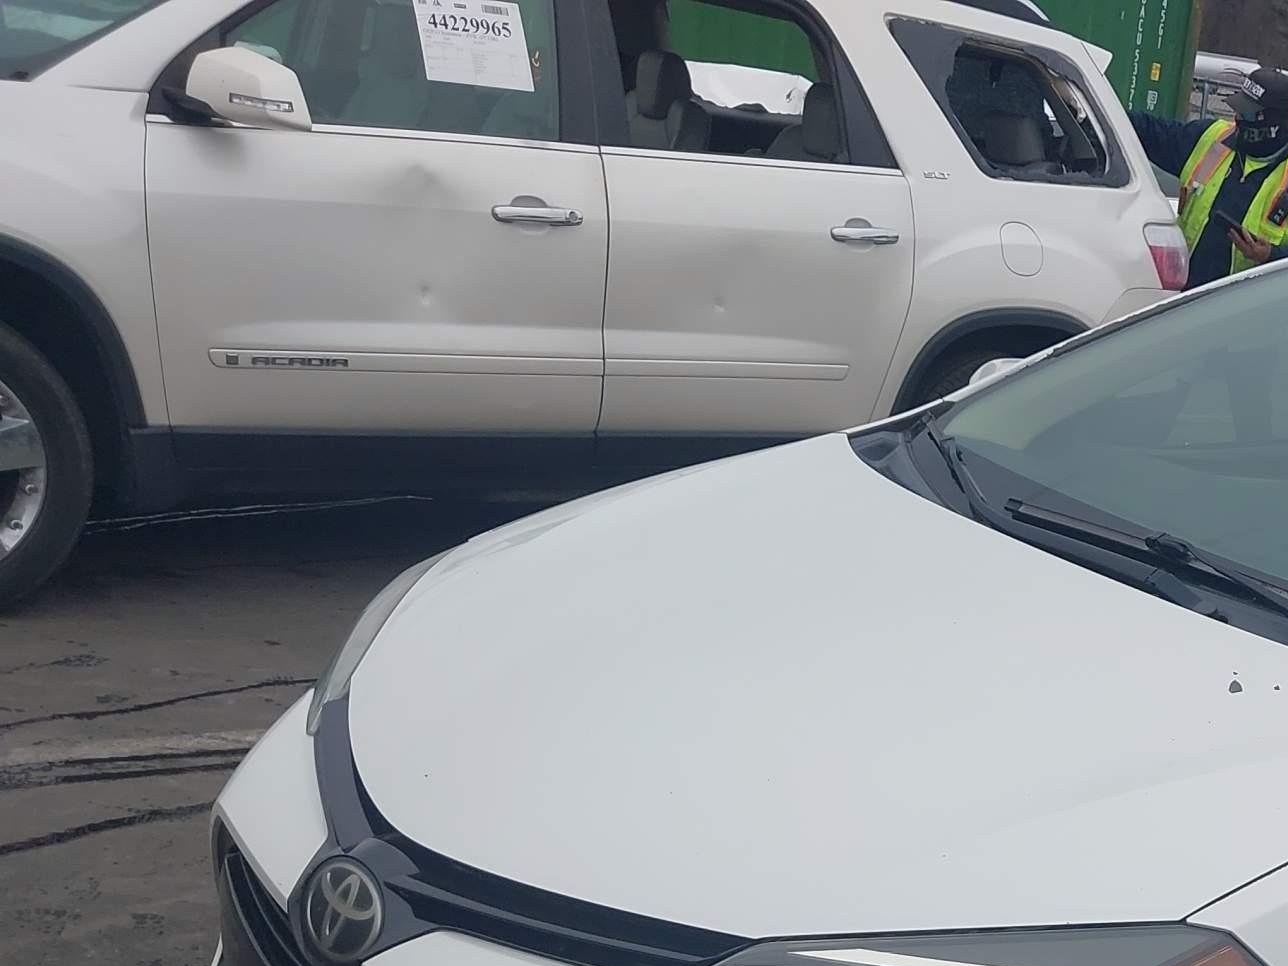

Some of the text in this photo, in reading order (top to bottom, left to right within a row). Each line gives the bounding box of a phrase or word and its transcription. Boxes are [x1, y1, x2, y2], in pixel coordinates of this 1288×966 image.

[428, 13, 512, 38] 44229965
[922, 171, 951, 180] SLT
[251, 356, 349, 367] ACADIA
